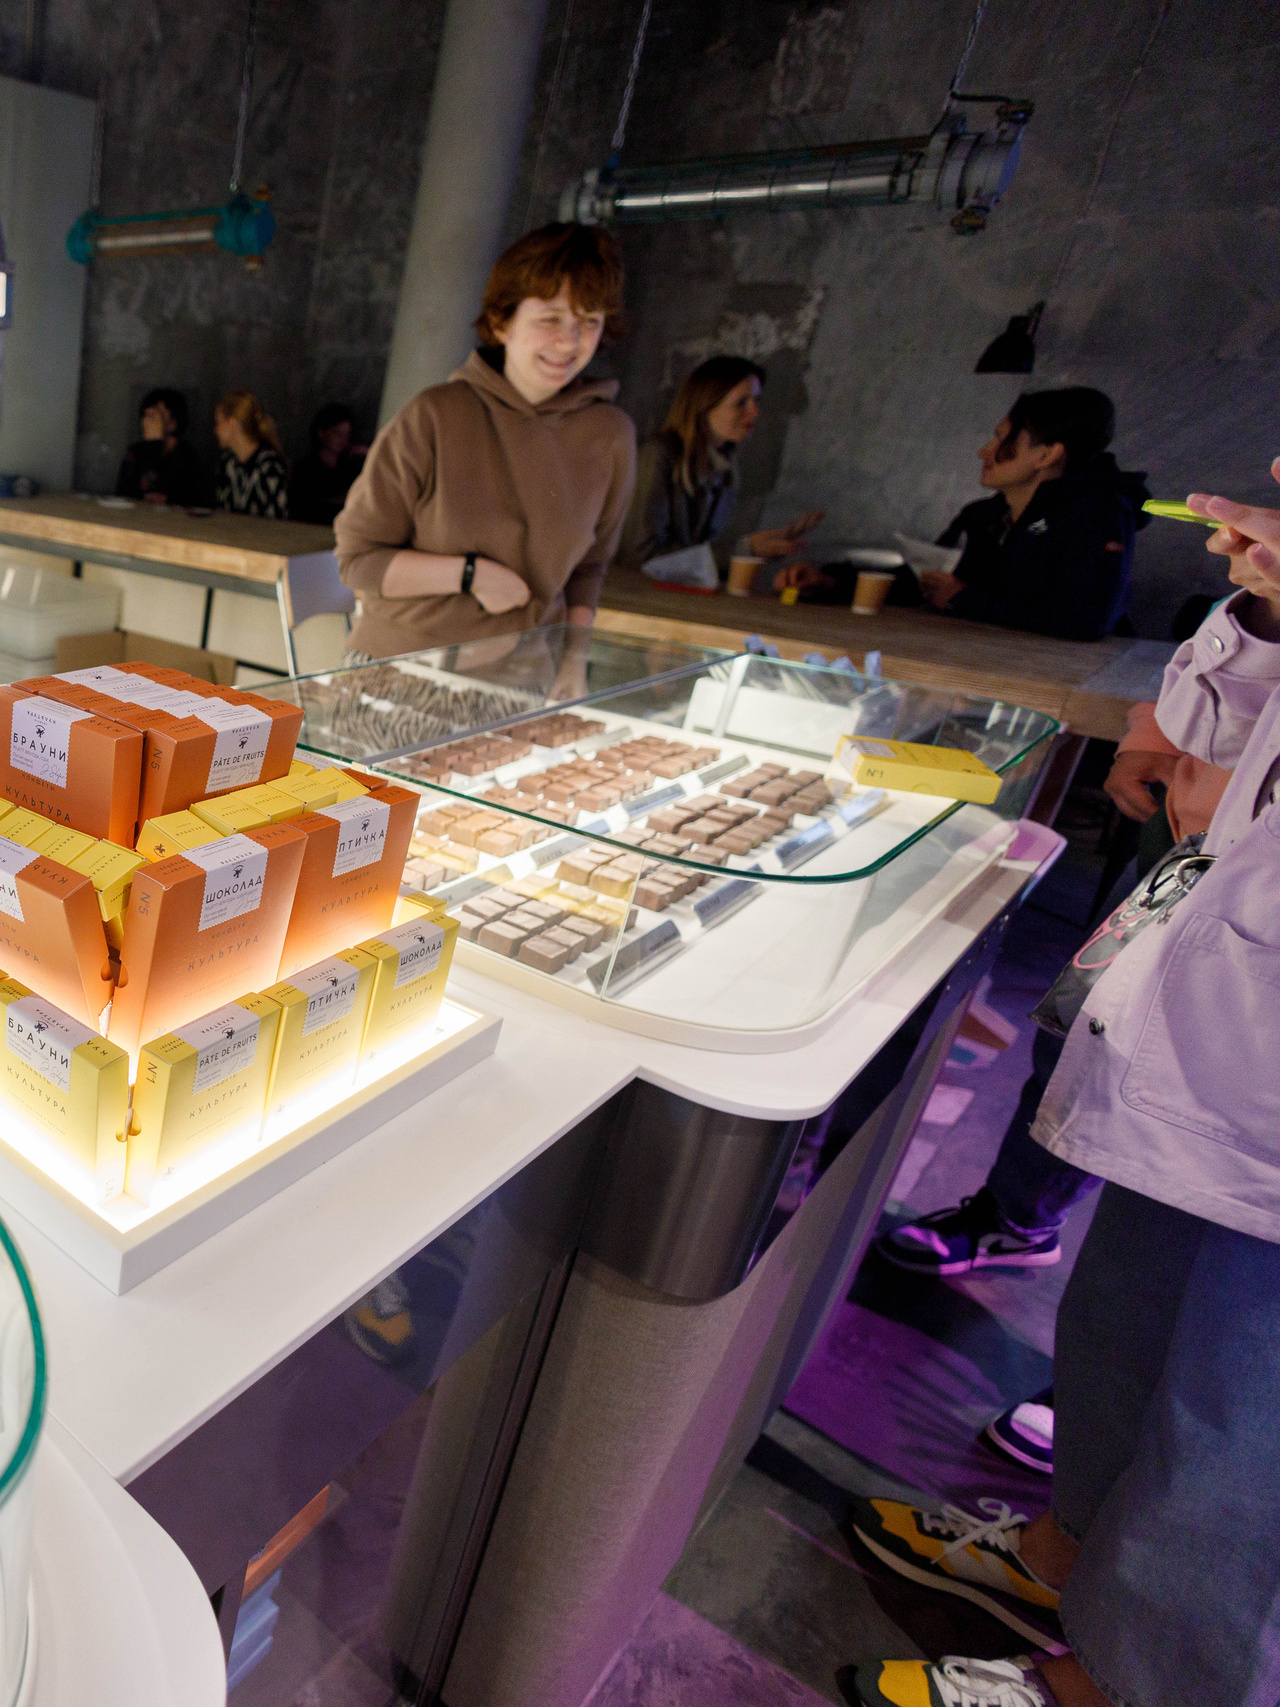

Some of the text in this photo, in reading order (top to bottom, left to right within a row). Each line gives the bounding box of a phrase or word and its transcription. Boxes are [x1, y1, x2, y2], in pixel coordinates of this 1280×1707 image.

[13, 732, 67, 762] БРАУНИ
[213, 750, 265, 768] PÂTE DE FRUITS
[5, 785, 70, 822] КУЛЬТУРА
[338, 829, 385, 853] ПТИЧКА
[206, 875, 263, 904] ШОКОЛАД
[321, 884, 379, 913] КУЛЬТУРА
[187, 935, 259, 972] КУЛЬТУРА
[400, 940, 442, 966] ШОКОЛАД
[309, 982, 356, 1012] ПТИЧКА
[390, 985, 433, 1012] КУЛЬТУРА
[8, 1017, 69, 1069] БРАУНИ
[199, 1033, 258, 1068] PÂTE DE FRUITS
[299, 1029, 348, 1061] КУЛЬТУРА
[7, 1066, 67, 1115] КУЛЬТУРА
[189, 1081, 248, 1119] КУЛЬТУРА
